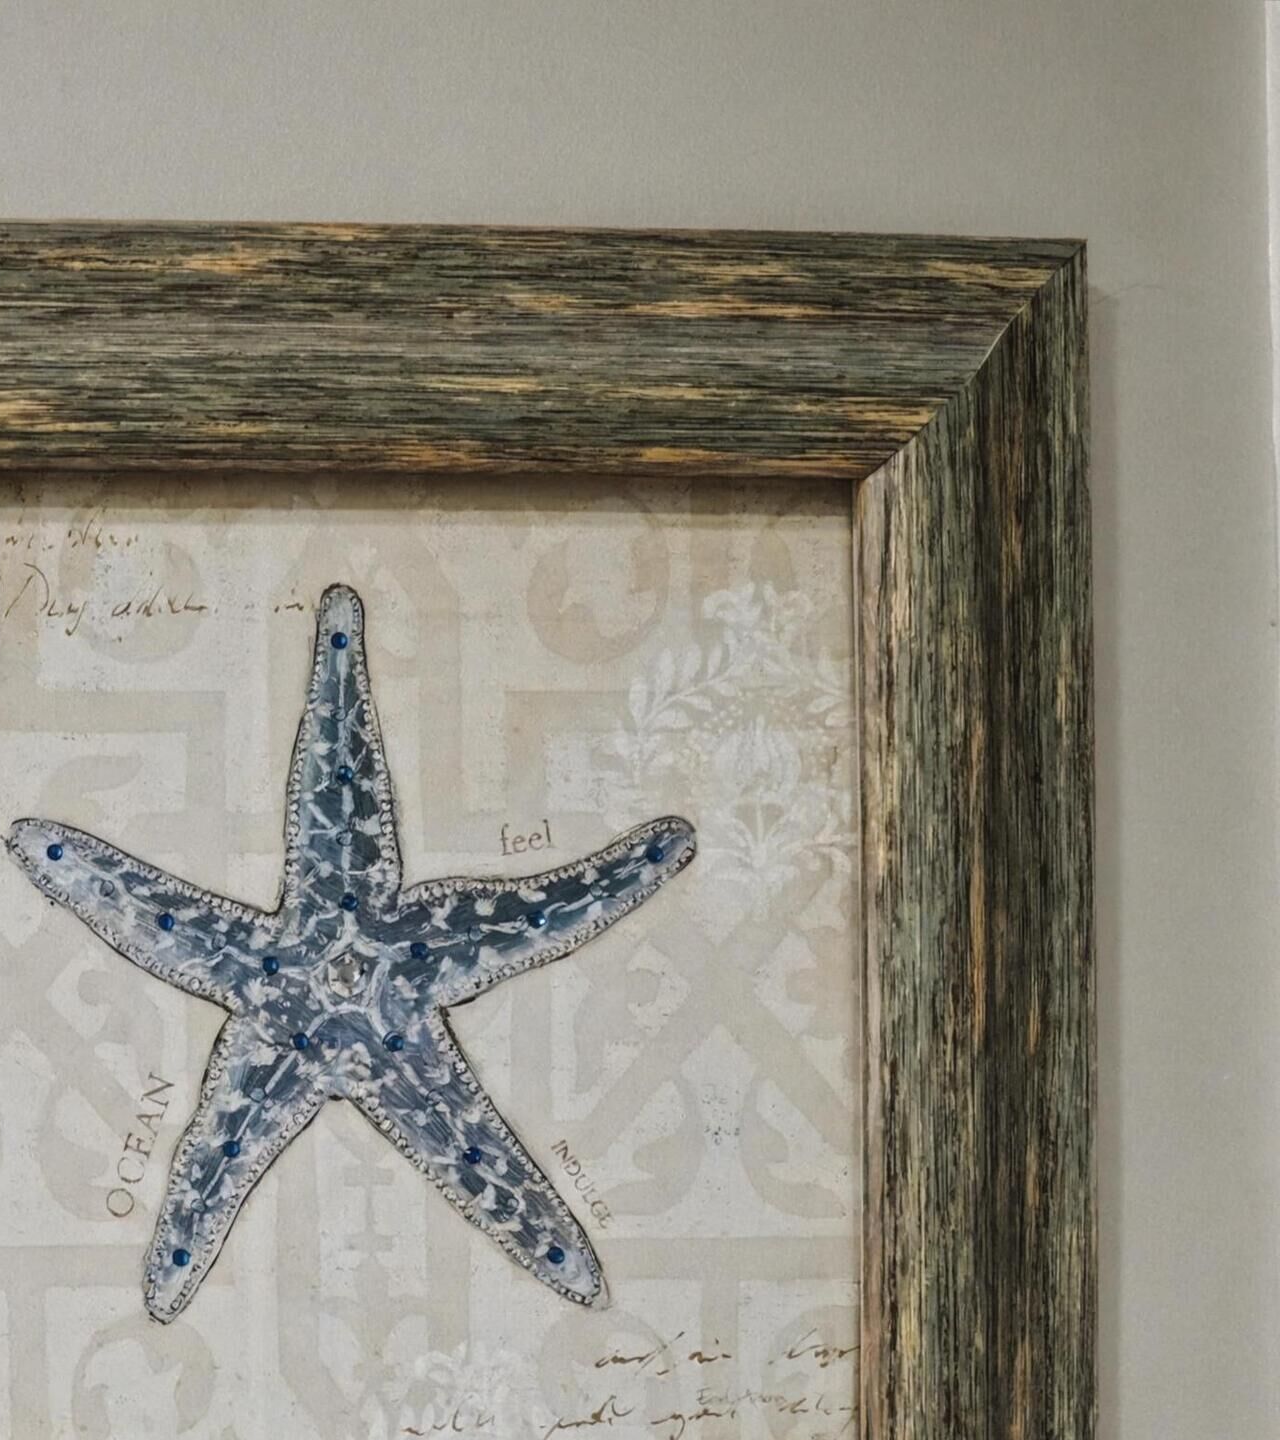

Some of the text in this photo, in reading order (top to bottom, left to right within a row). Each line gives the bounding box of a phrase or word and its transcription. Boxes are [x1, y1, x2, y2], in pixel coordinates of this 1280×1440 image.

[500, 818, 558, 857] feel
[105, 1071, 176, 1219] OCEAN
[550, 1139, 612, 1230] INDULGE
